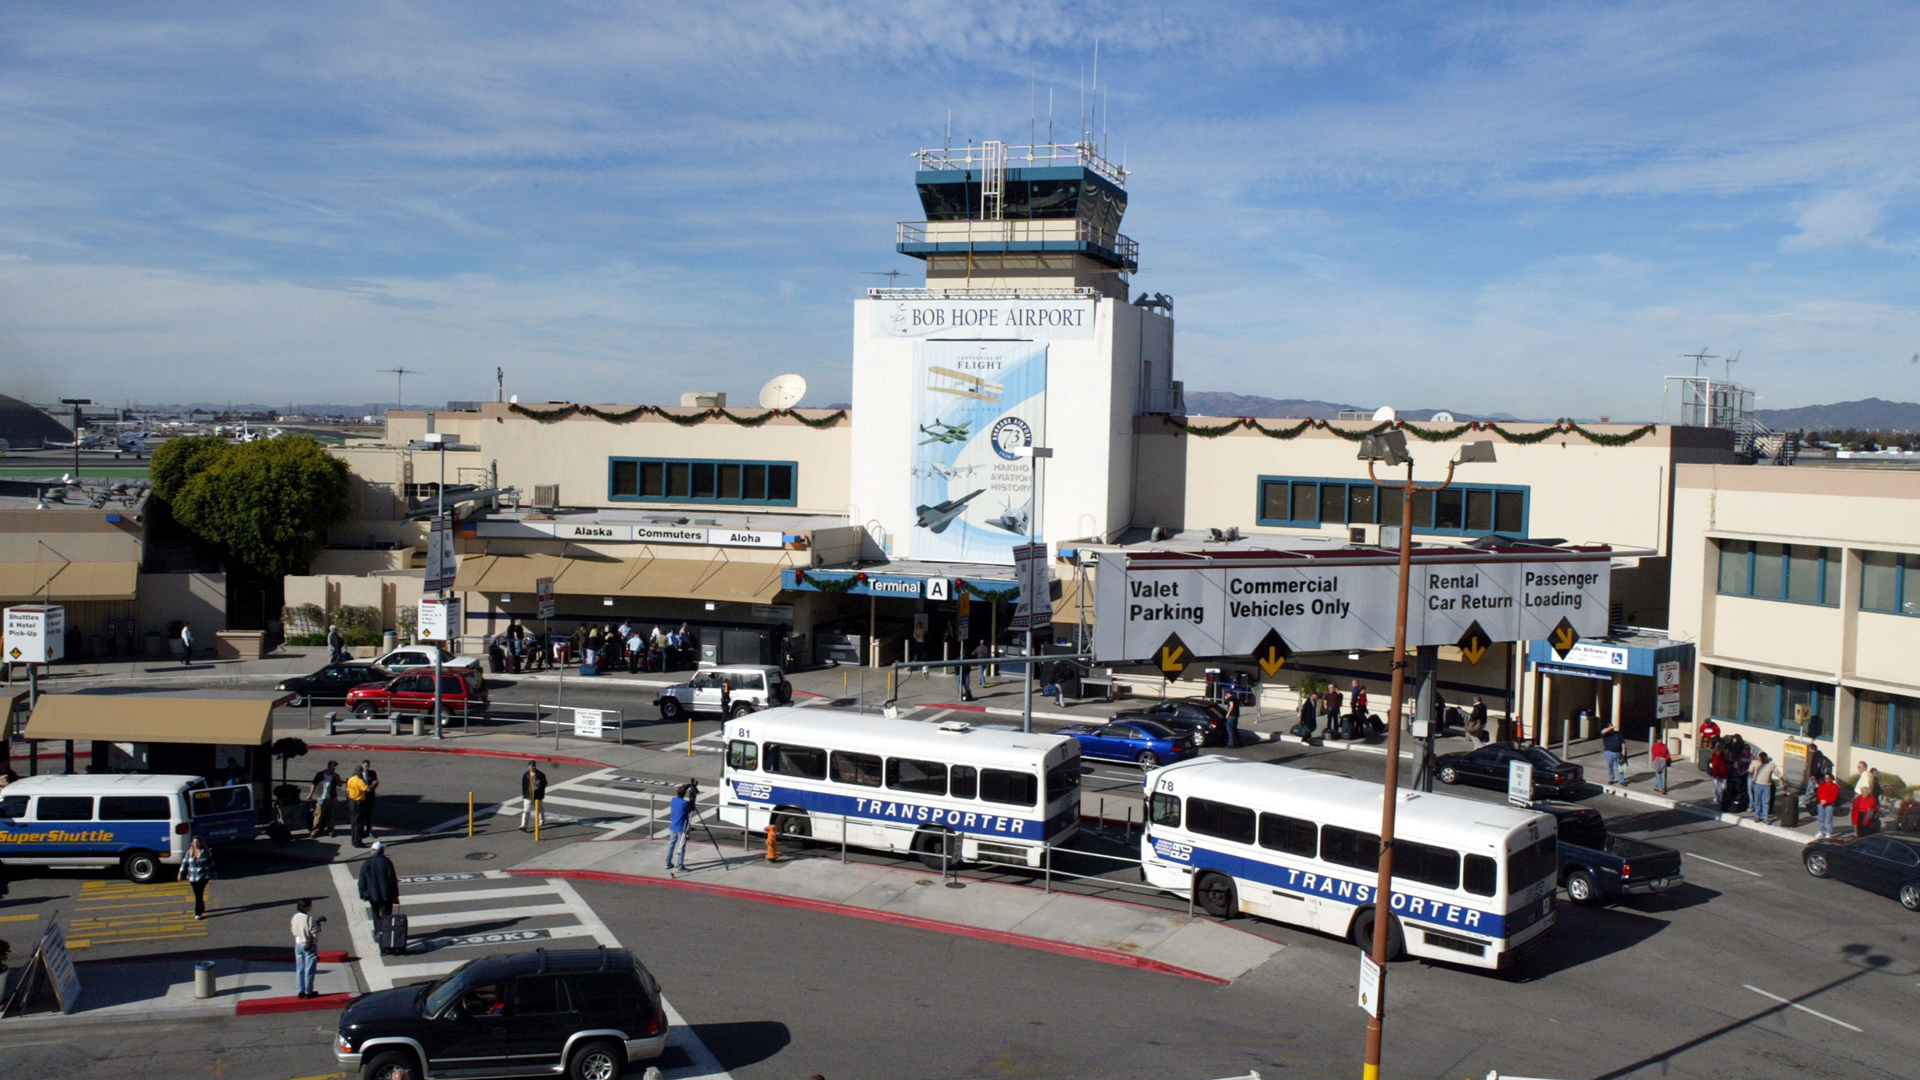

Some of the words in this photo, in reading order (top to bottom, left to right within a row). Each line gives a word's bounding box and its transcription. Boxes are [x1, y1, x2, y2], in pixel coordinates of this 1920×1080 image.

[912, 308, 945, 327] BOB
[951, 308, 999, 327] HOPE
[1005, 308, 1086, 327] AIRPORT
[957, 361, 1003, 370] FLIGHT
[1002, 428, 1020, 449] 73
[993, 464, 1030, 472] MAKING
[990, 473, 1033, 482] AVIATION
[990, 483, 1032, 492] HISTORY
[574, 526, 613, 537] Alaska
[638, 528, 702, 540] Commuters
[730, 533, 761, 543] Aloha
[867, 578, 920, 593] Terminal
[931, 581, 943, 597] A
[1229, 576, 1338, 595] Commercial
[1429, 573, 1479, 589] Rental
[1525, 571, 1599, 589] Passenger
[1130, 580, 1179, 598] Valet
[1229, 599, 1305, 618] Vehicles
[1310, 598, 1351, 619] Only
[1428, 595, 1455, 611] Car
[1460, 594, 1513, 610] Return
[1525, 591, 1582, 610] Loading
[8, 613, 39, 621] Shuttles
[1129, 602, 1204, 624] Parking
[738, 727, 751, 739] 81
[1160, 779, 1175, 792] 78
[855, 797, 1026, 834] TRANSPORTER
[0, 829, 114, 845] SuperShuttle
[1528, 825, 1540, 843] 78
[1287, 868, 1482, 928] TRANSORTER
